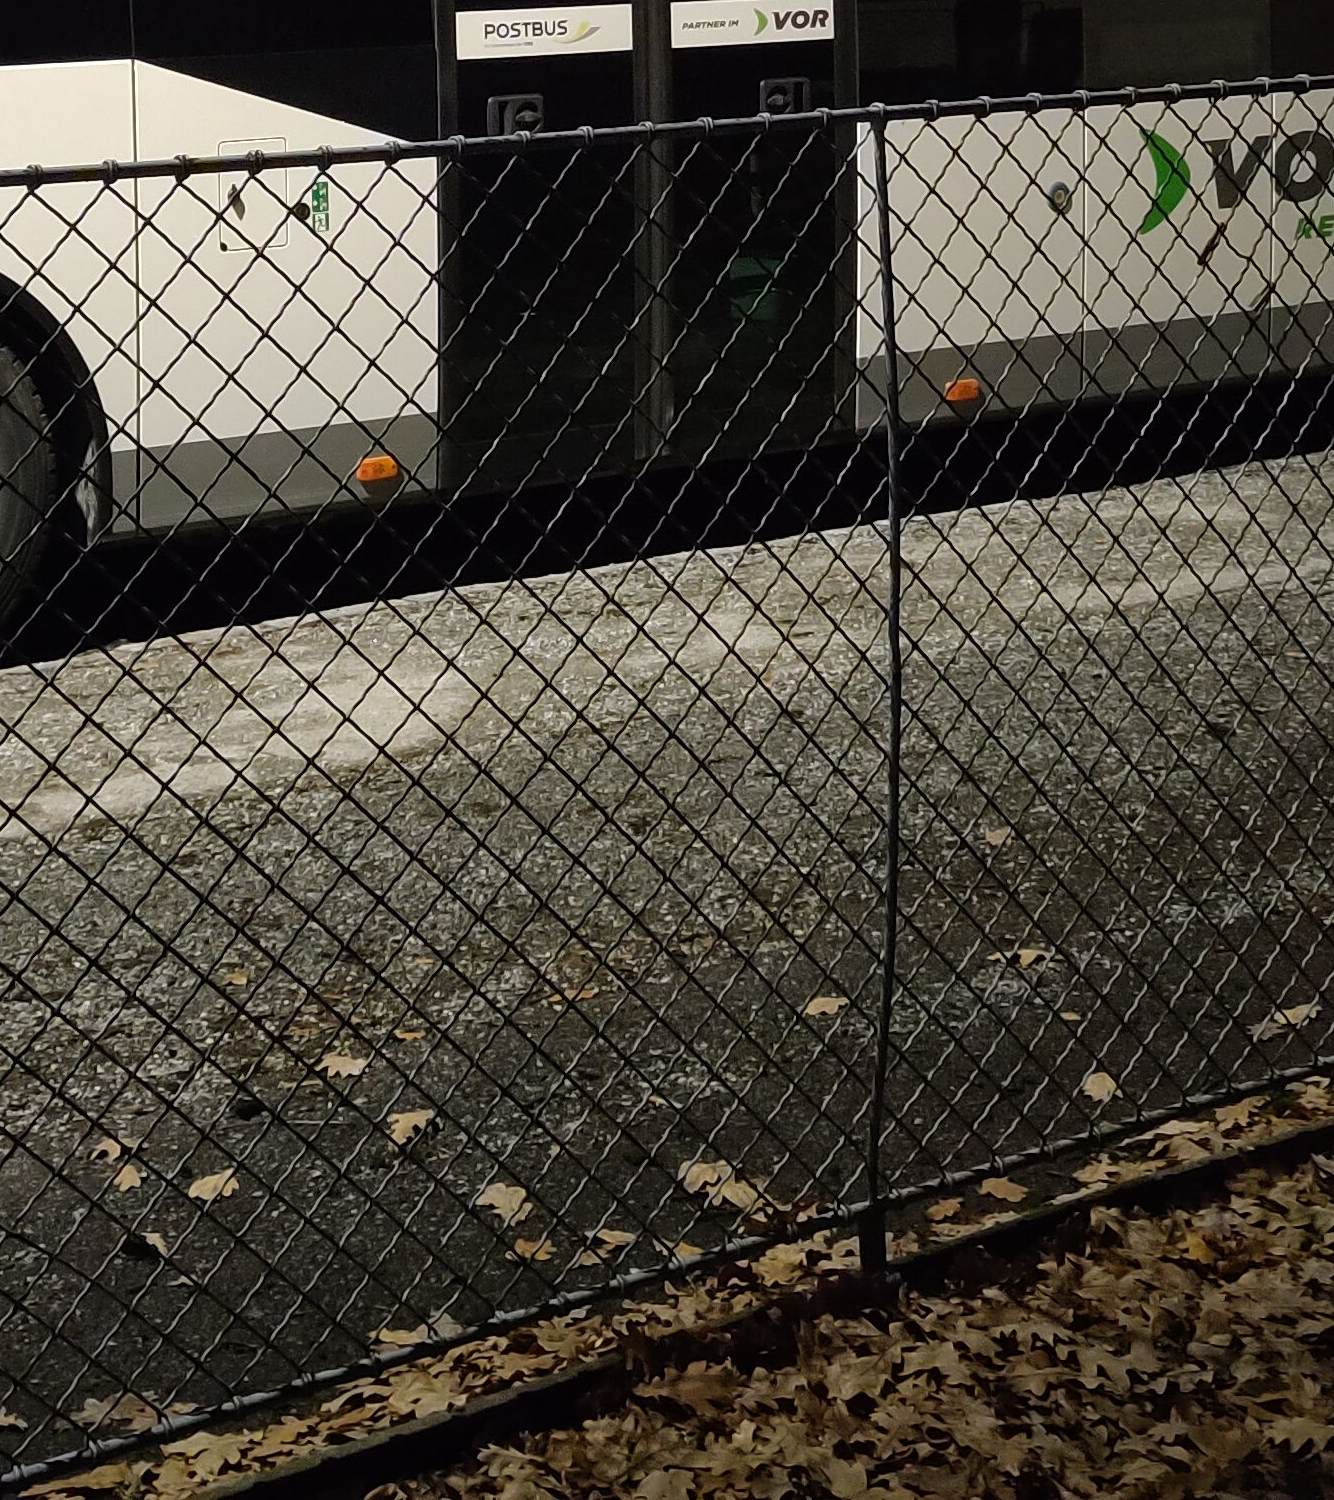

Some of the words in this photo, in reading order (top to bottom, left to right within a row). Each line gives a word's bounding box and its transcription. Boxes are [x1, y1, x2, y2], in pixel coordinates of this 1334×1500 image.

[483, 19, 569, 40] POSTBUS
[681, 19, 726, 31] PARTNER
[771, 8, 830, 31] VOR
